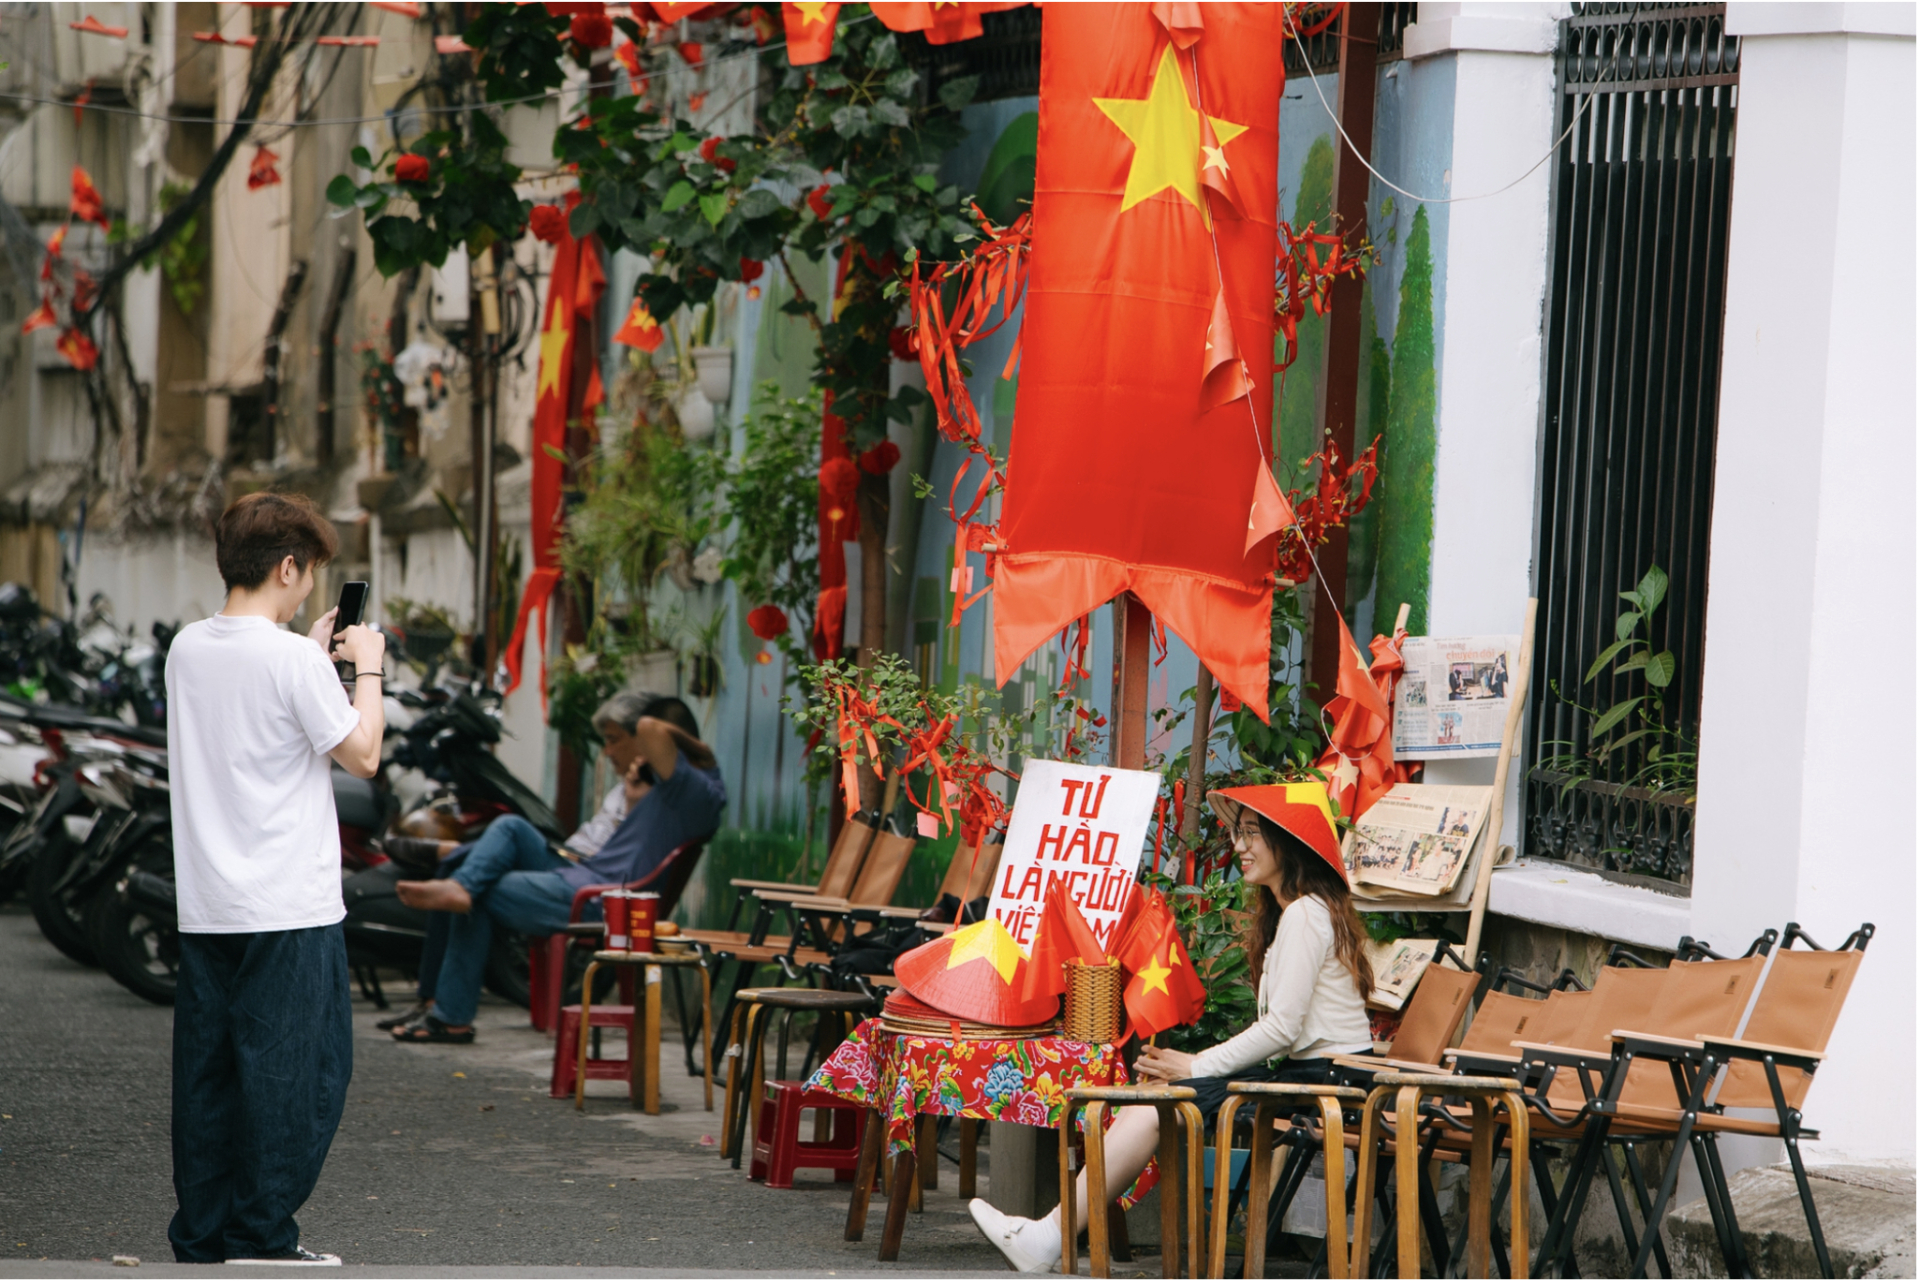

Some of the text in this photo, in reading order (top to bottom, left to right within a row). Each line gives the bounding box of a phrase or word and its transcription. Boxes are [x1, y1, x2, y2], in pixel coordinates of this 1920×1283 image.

[1060, 774, 1112, 823] TỰ
[1036, 822, 1120, 866] HÀO
[1000, 861, 1043, 902] LÀ
[995, 904, 1043, 949] VIỆ
